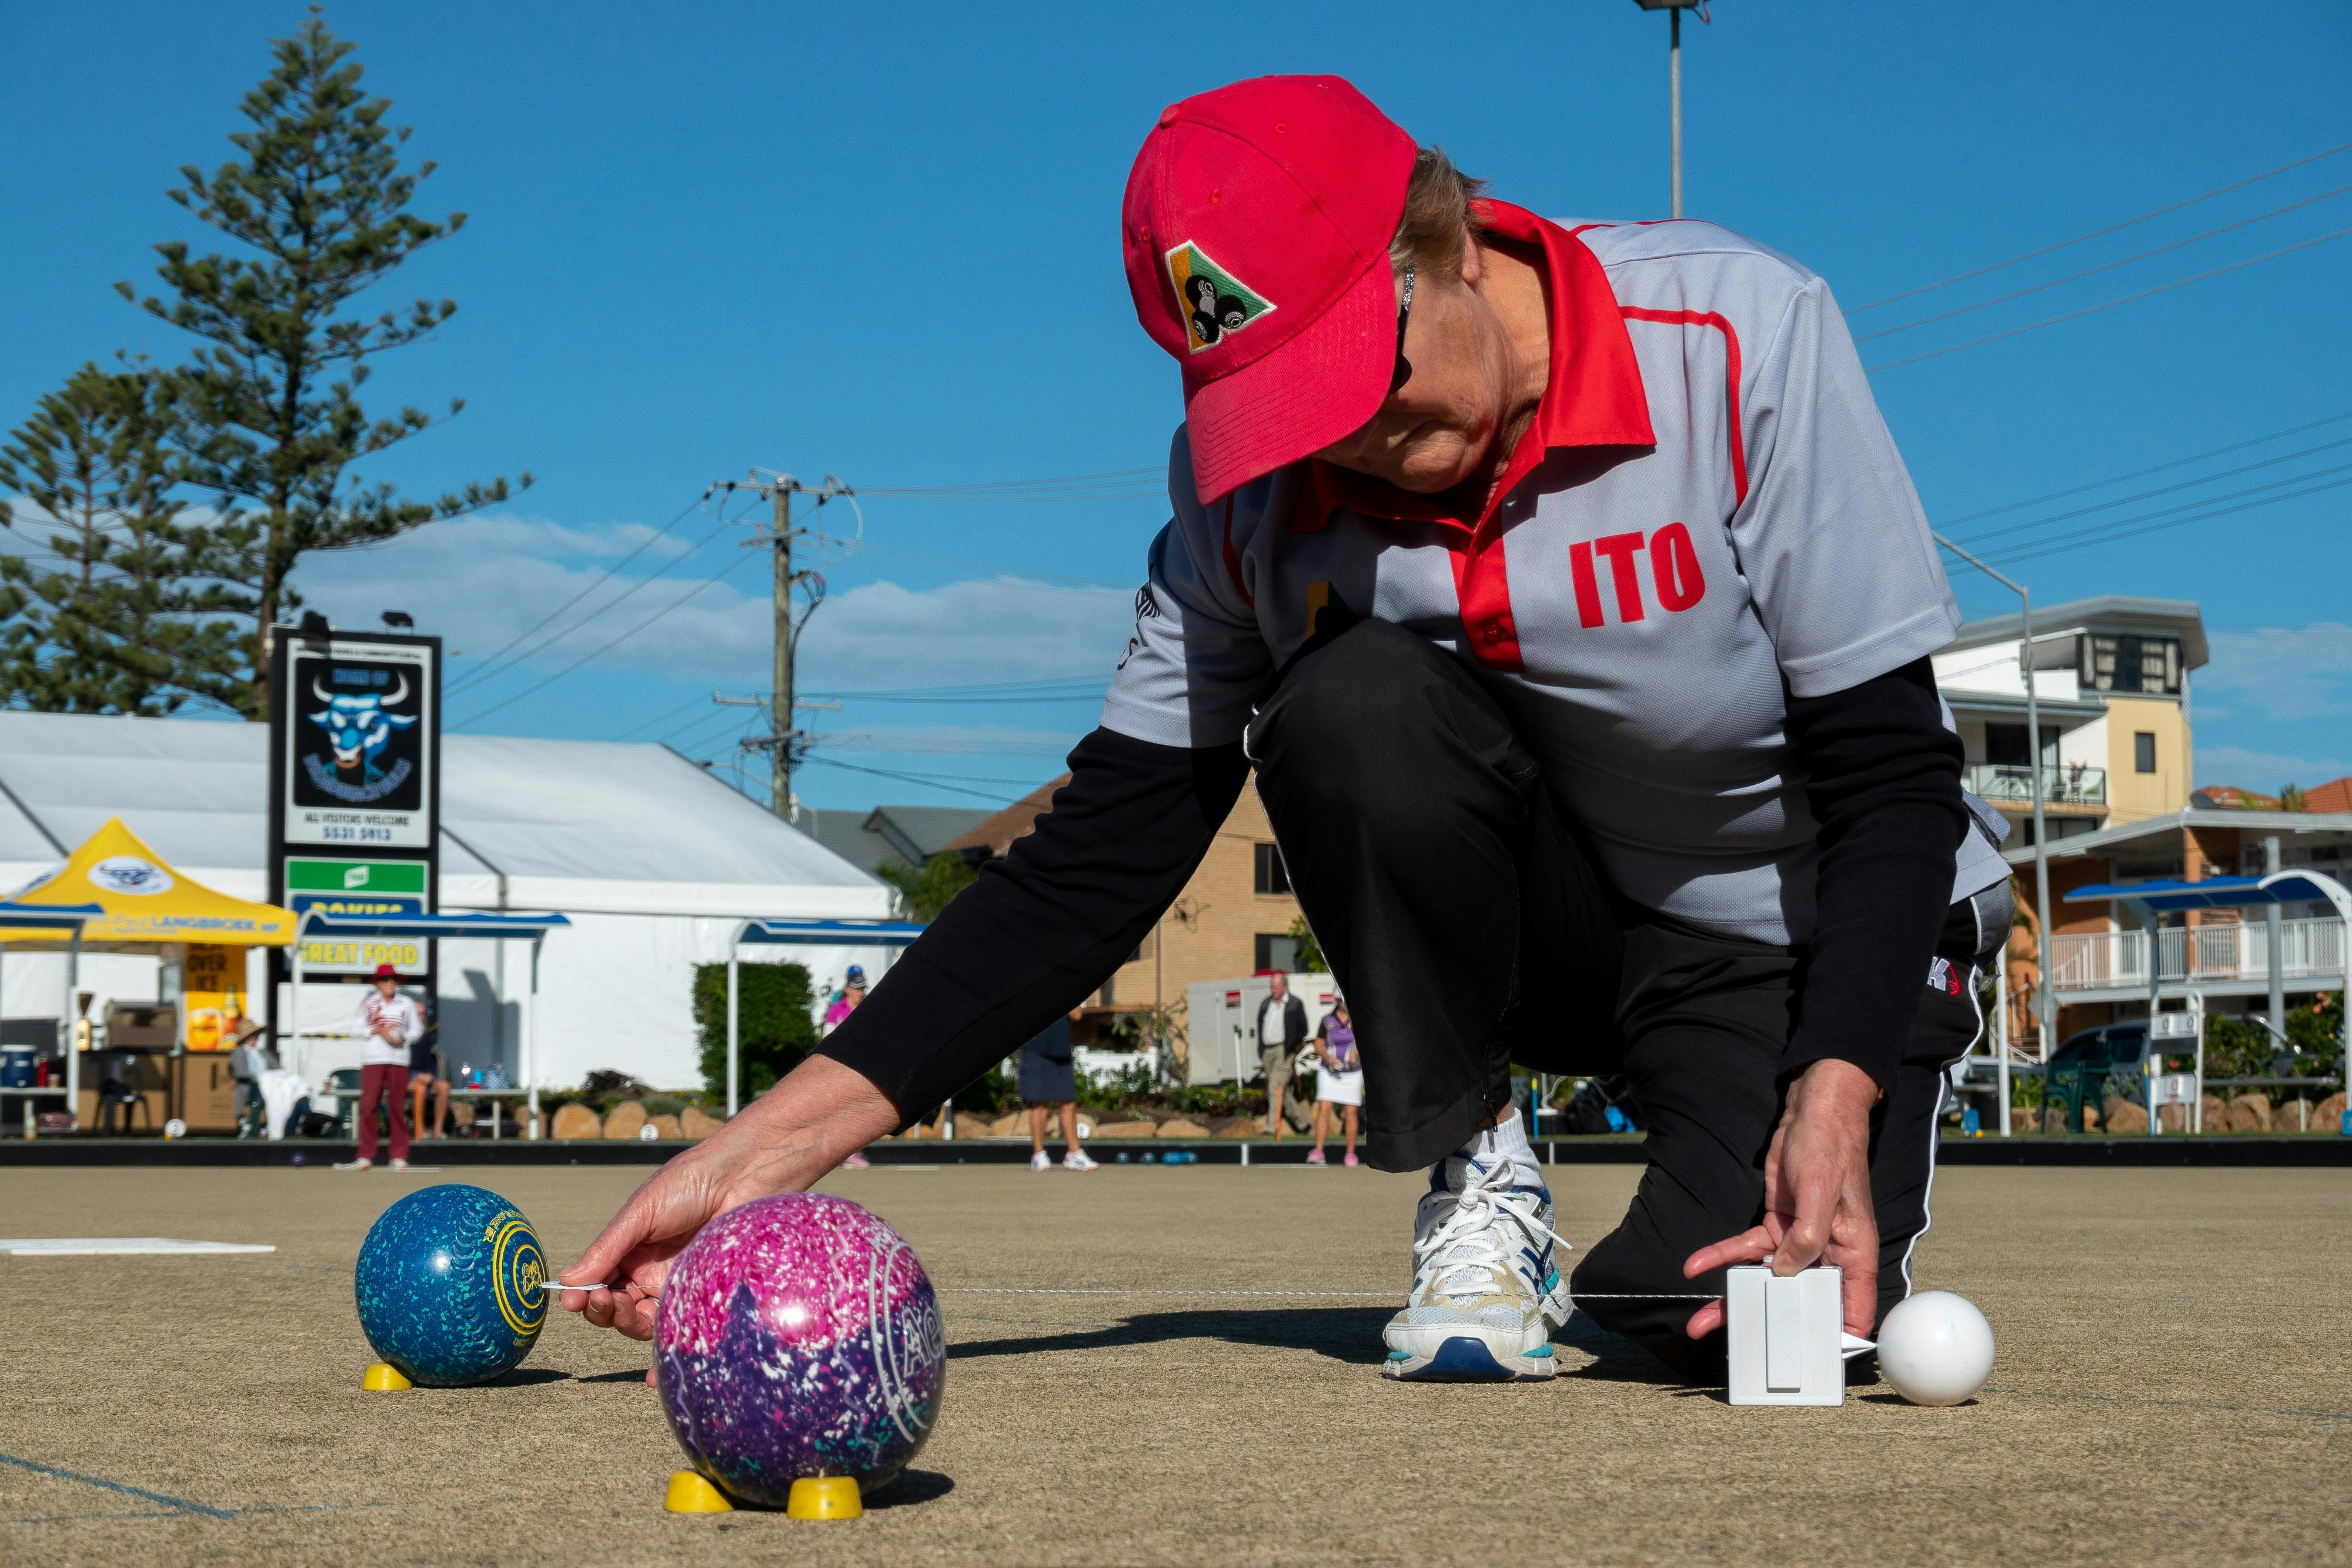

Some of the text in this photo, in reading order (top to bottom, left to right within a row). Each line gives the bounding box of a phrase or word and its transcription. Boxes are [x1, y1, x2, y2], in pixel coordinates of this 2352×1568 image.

[1569, 522, 1706, 628] ITO
[305, 813, 409, 825] ALL VISITORS WELCOME
[323, 826, 353, 838] 5531
[152, 915, 256, 931] LANGBROEK
[363, 942, 417, 965] FOOD
